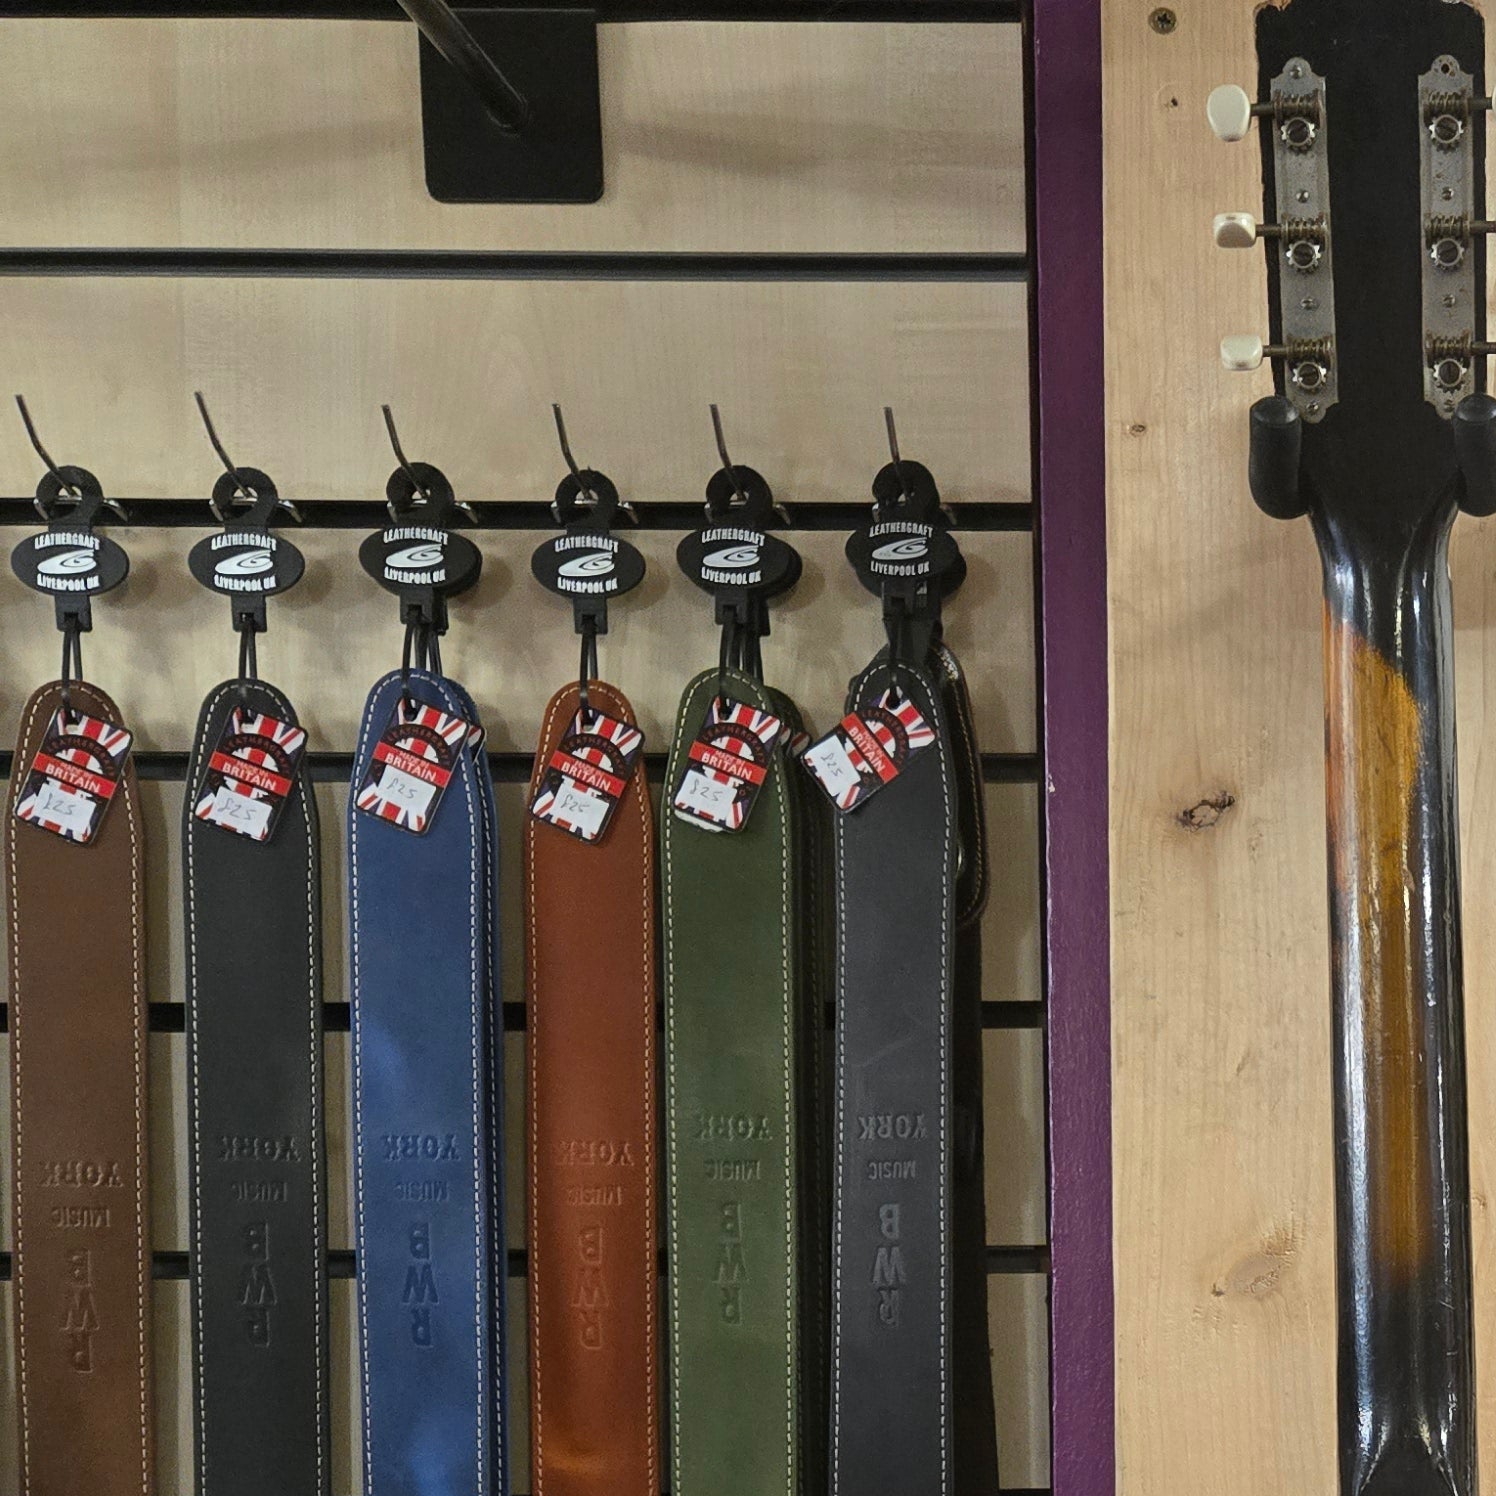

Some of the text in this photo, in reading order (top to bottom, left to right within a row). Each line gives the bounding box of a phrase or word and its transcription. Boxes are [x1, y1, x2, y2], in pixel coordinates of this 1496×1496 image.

[384, 566, 446, 584] LIVERPOOL UK
[701, 567, 761, 584] LIVERPOOL UK
[870, 560, 930, 577] LIVERPOOL UK
[37, 574, 100, 591] LIVERPOOL UK
[214, 574, 276, 591] LIVERPOOL UK
[557, 576, 618, 593] LIVERPOOL UK
[848, 727, 886, 772] BRITAIN
[222, 762, 277, 791] BRITAIN
[385, 753, 437, 782] BRITAIN
[561, 761, 611, 791] BRITAIN
[701, 752, 752, 780] BRITAIN
[821, 752, 843, 777] £25
[45, 763, 100, 793] BRITAIN
[387, 778, 418, 799] £25
[690, 779, 723, 801] £25
[43, 792, 76, 815] £25
[217, 797, 257, 820] £25
[561, 794, 590, 813] £25
[699, 1114, 773, 1142] YORK
[857, 1114, 928, 1141] YORK
[218, 1134, 302, 1163] YORK
[383, 1134, 462, 1163] YORK
[555, 1140, 635, 1167] YORK
[37, 1160, 124, 1188] YORK
